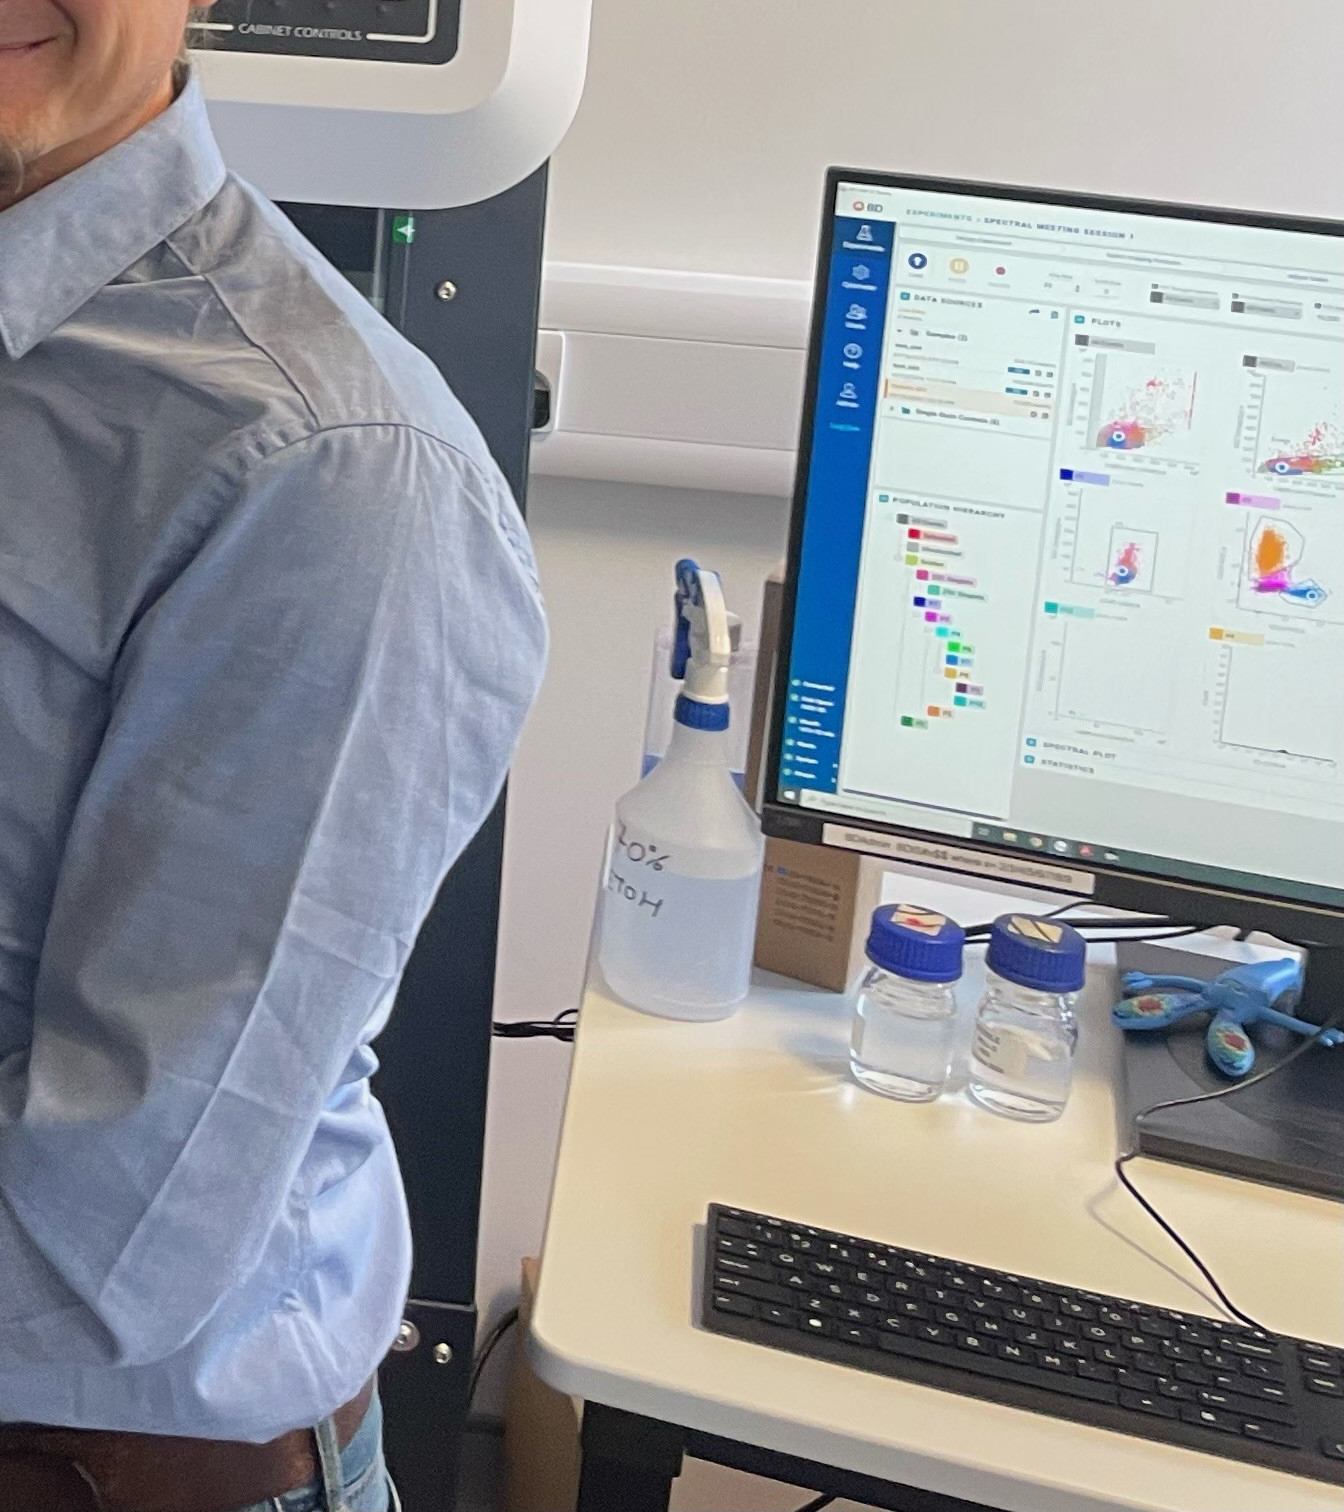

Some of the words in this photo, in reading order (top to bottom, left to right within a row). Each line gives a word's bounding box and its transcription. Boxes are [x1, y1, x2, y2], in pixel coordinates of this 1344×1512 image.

[238, 23, 292, 37] CABINET
[293, 26, 362, 41] CONTROLS
[866, 202, 884, 214] BD
[1091, 317, 1121, 328] PLOTS
